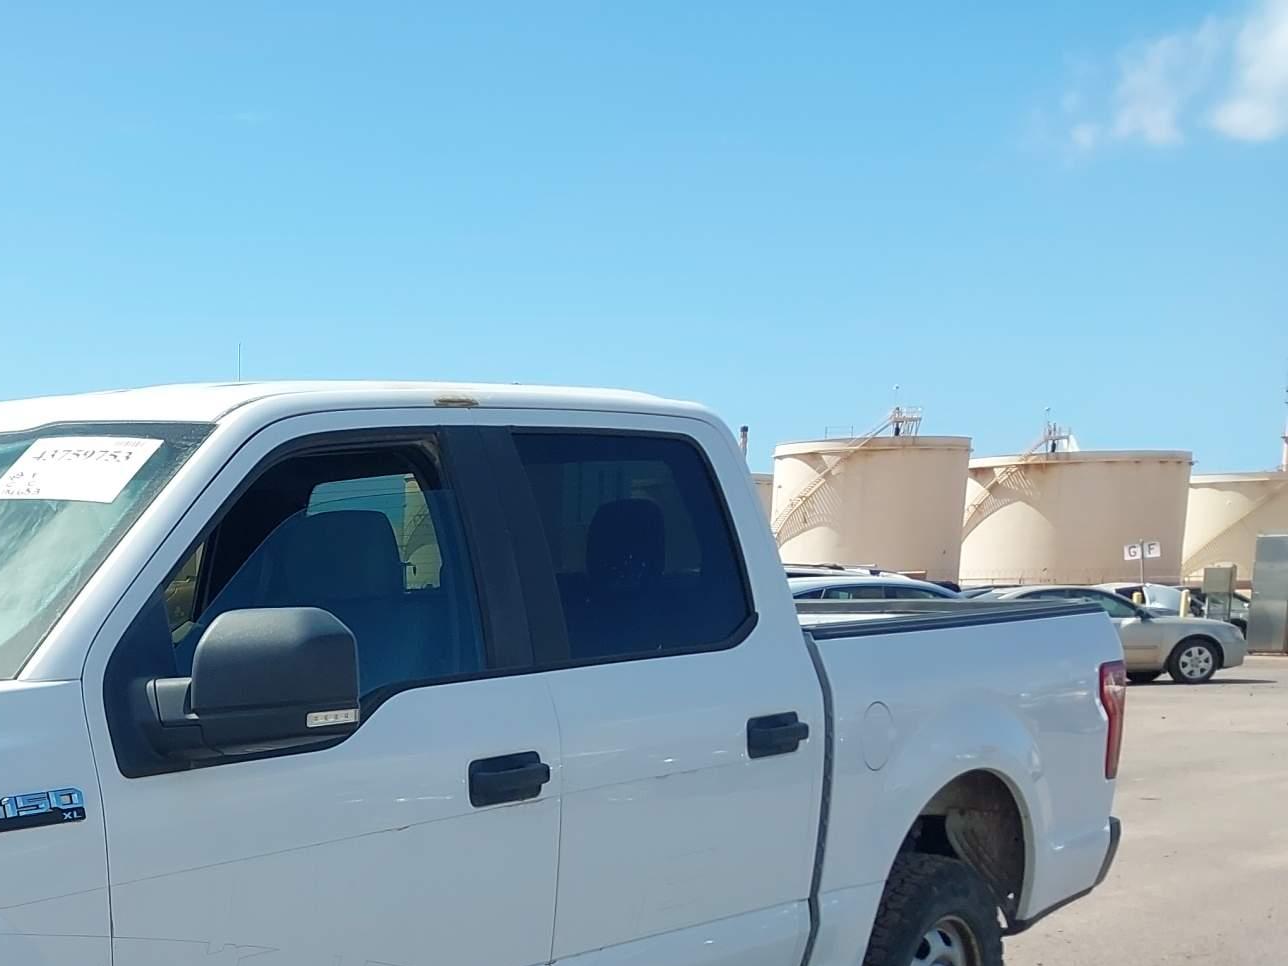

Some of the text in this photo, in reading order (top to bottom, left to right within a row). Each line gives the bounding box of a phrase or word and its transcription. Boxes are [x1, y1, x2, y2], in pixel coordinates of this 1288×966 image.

[1128, 545, 1137, 558] G
[1147, 542, 1157, 555] F
[63, 811, 82, 821] XL
